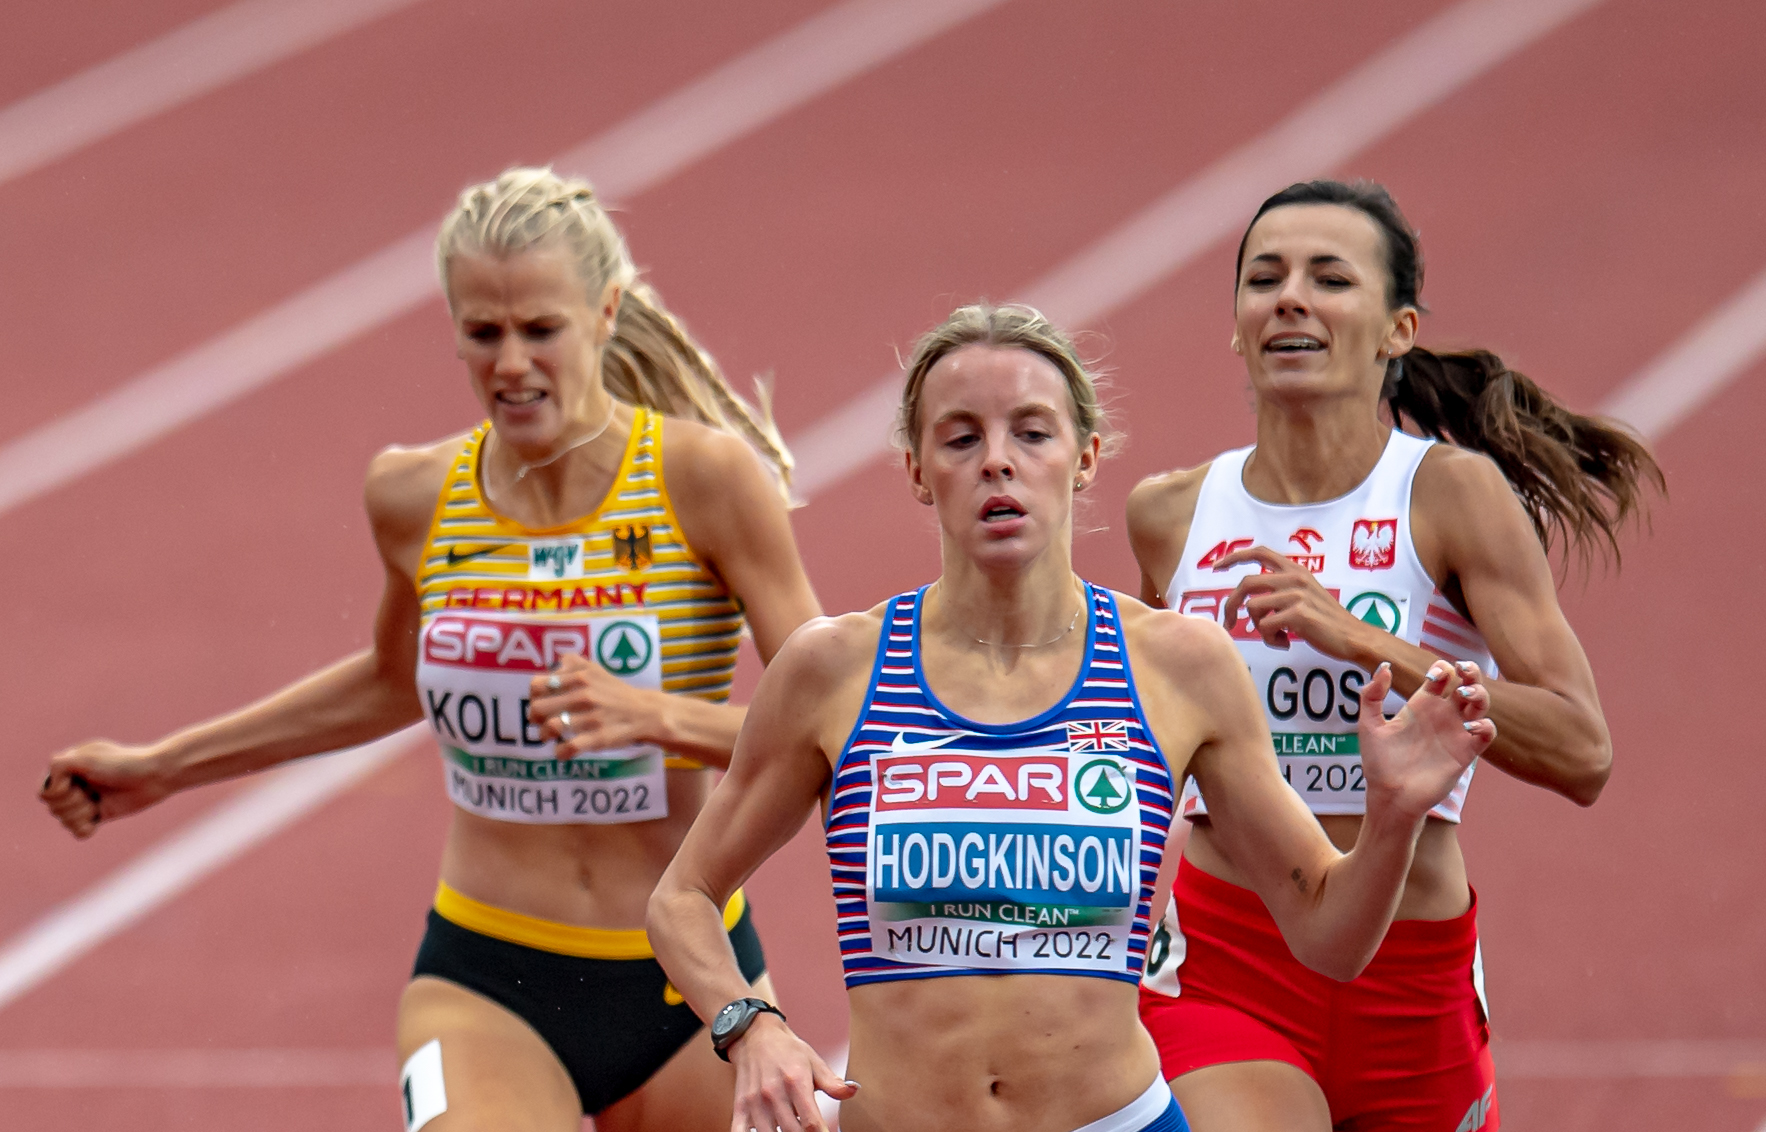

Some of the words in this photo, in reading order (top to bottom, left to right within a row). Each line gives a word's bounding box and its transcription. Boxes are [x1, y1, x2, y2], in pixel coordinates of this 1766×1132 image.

[445, 583, 649, 612] GERMANY
[428, 622, 586, 668] SPAR
[427, 689, 564, 747] KOLB
[453, 770, 558, 814] MUNICH
[571, 784, 650, 815] 2022
[881, 761, 1063, 804] SPAR
[1306, 764, 1365, 792] 202
[875, 832, 1131, 894] HODGKINSON
[931, 905, 936, 916] I
[945, 904, 992, 919] RUN
[887, 926, 1019, 959] MUNICH
[1032, 931, 1112, 960] 2022
